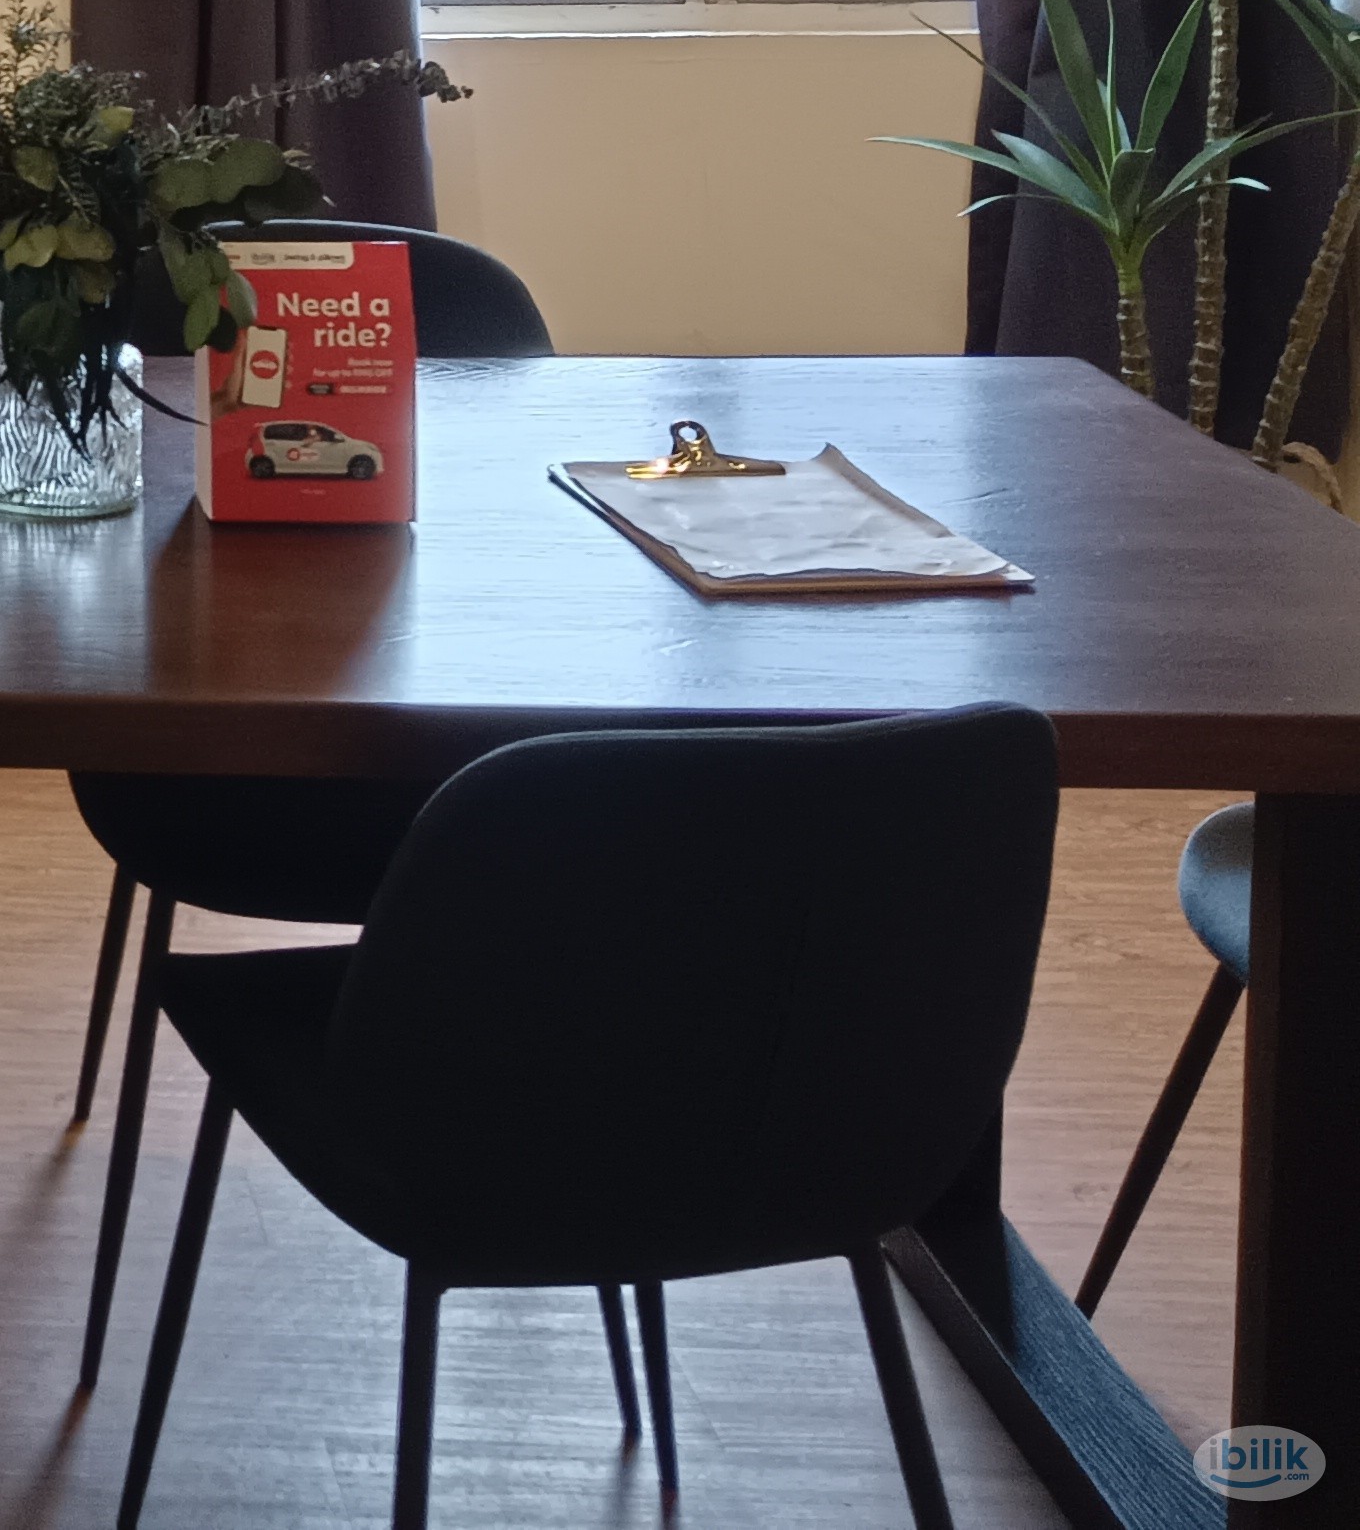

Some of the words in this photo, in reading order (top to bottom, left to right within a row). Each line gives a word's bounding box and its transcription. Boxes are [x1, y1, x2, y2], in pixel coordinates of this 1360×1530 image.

[276, 291, 360, 318] Need
[369, 297, 390, 317] a
[313, 322, 392, 348] ride?
